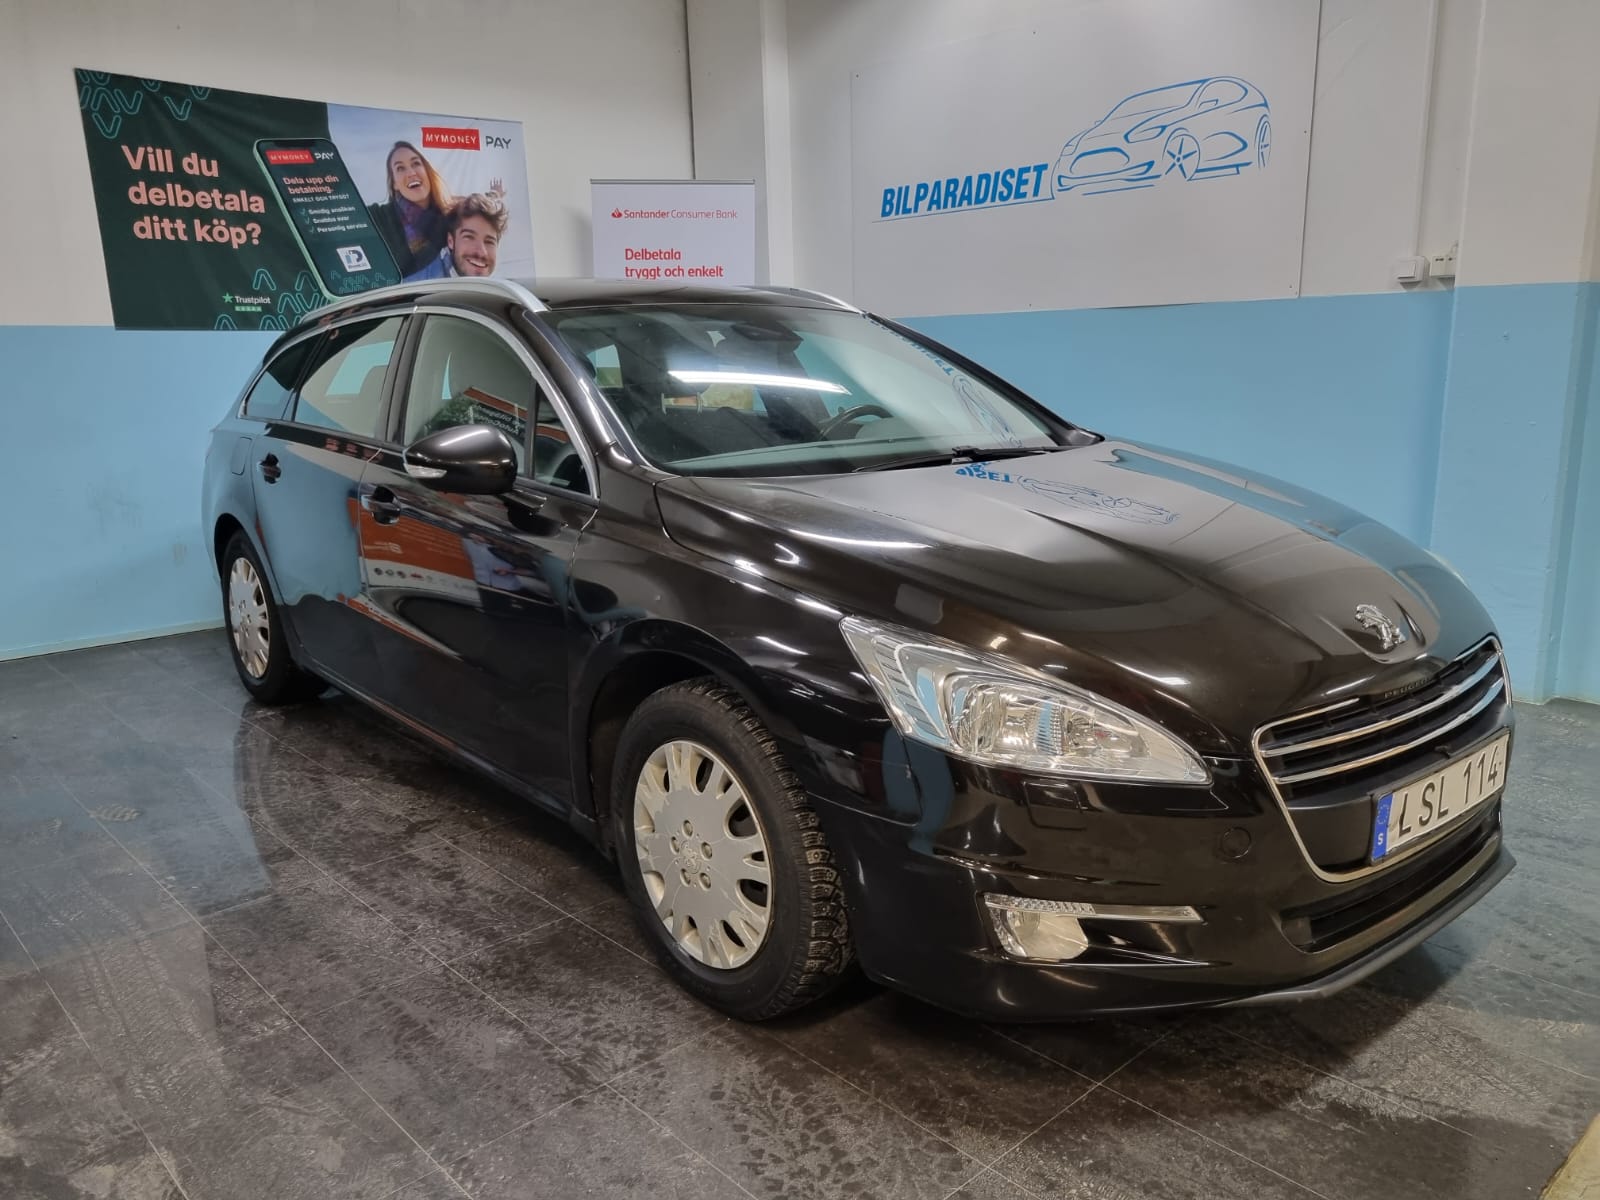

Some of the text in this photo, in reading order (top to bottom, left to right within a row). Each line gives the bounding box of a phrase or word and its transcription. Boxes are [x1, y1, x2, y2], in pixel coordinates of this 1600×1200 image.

[425, 133, 512, 149] MYMONEY PAY
[121, 145, 219, 177] Vill du
[314, 152, 334, 160] PAY
[306, 176, 324, 185] upp
[325, 174, 339, 183] din
[128, 181, 266, 213] delbetala
[881, 163, 1048, 217] BILPARADISET
[624, 209, 738, 219] Santander Consumer Bank
[133, 216, 262, 249] ditt köp?
[625, 248, 682, 261] Delbetala
[625, 265, 724, 280] tryggt och enkelt
[234, 295, 271, 305] Trustpilot
[1398, 745, 1499, 839] LSL 114
[1377, 832, 1384, 846] S
